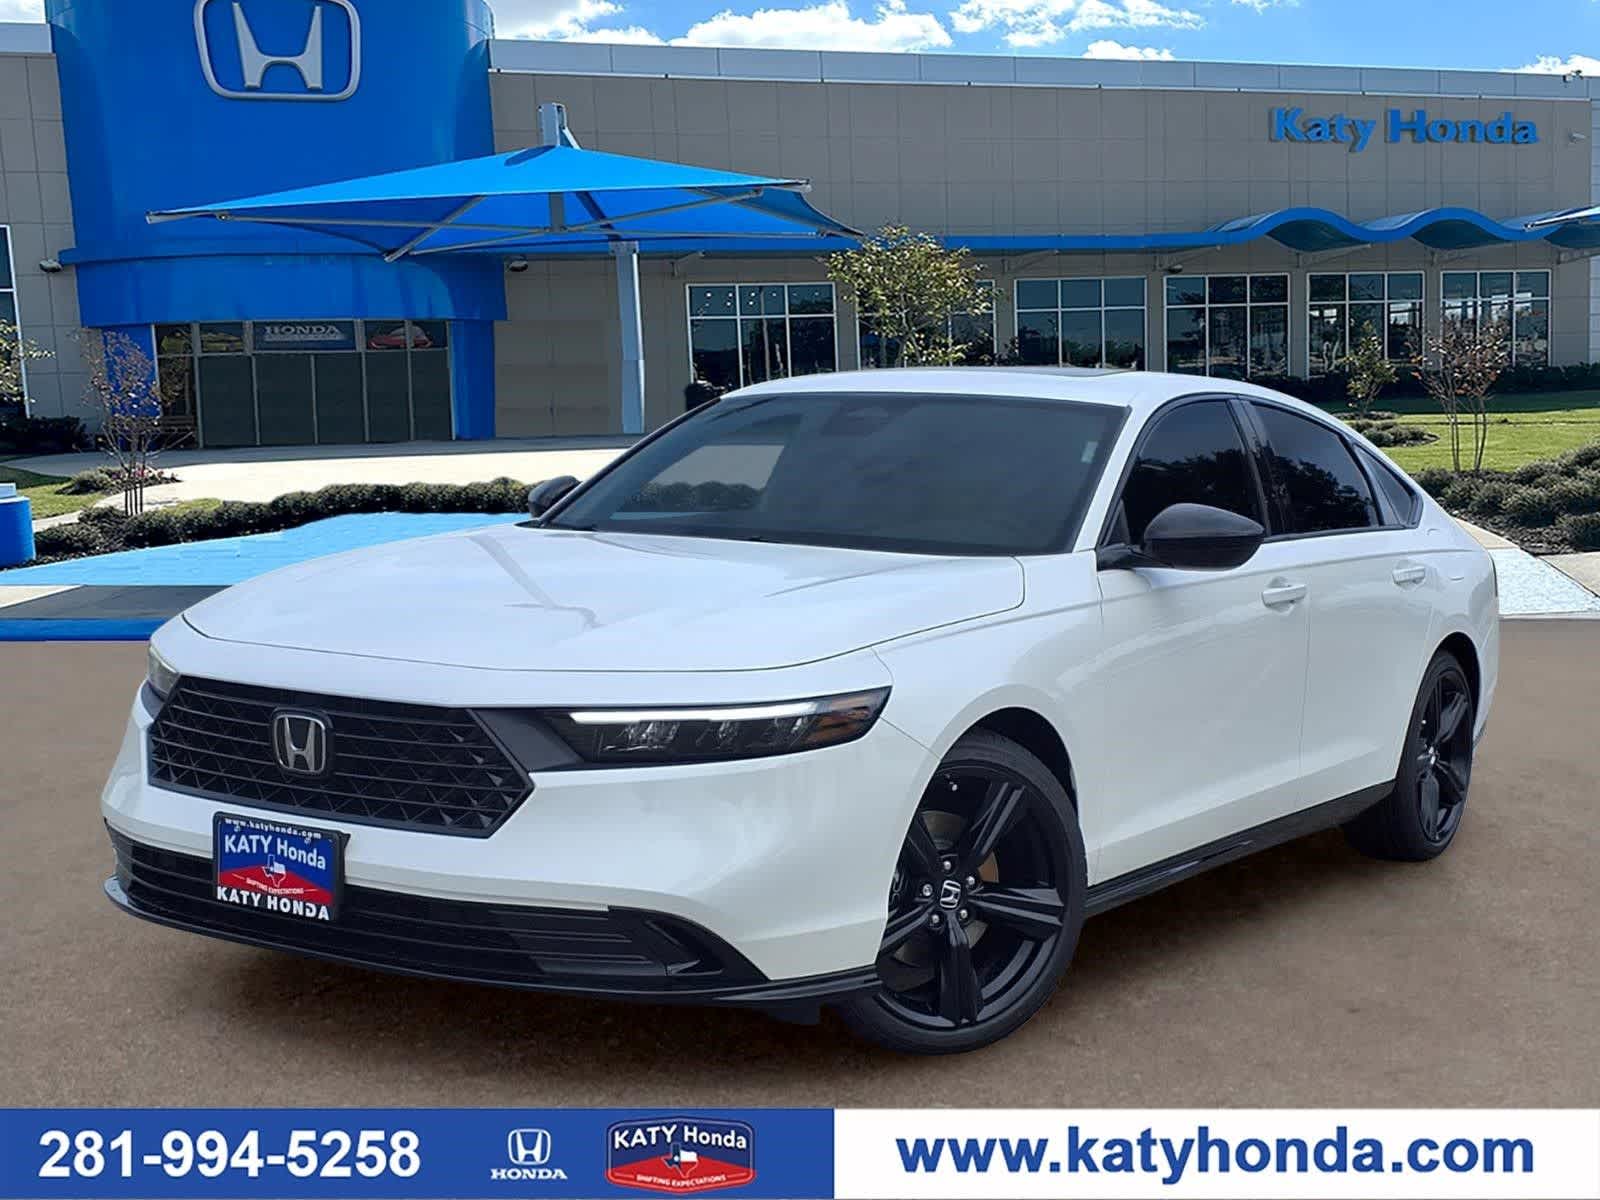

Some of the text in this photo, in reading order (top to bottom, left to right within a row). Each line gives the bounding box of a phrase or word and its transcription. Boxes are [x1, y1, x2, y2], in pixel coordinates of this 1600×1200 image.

[1270, 107, 1540, 152] Katy Honda
[264, 325, 341, 335] HONDA
[224, 818, 322, 839] www.katyhonda.com
[224, 834, 326, 871] KATY Honda
[216, 886, 330, 921] KATY HONDA
